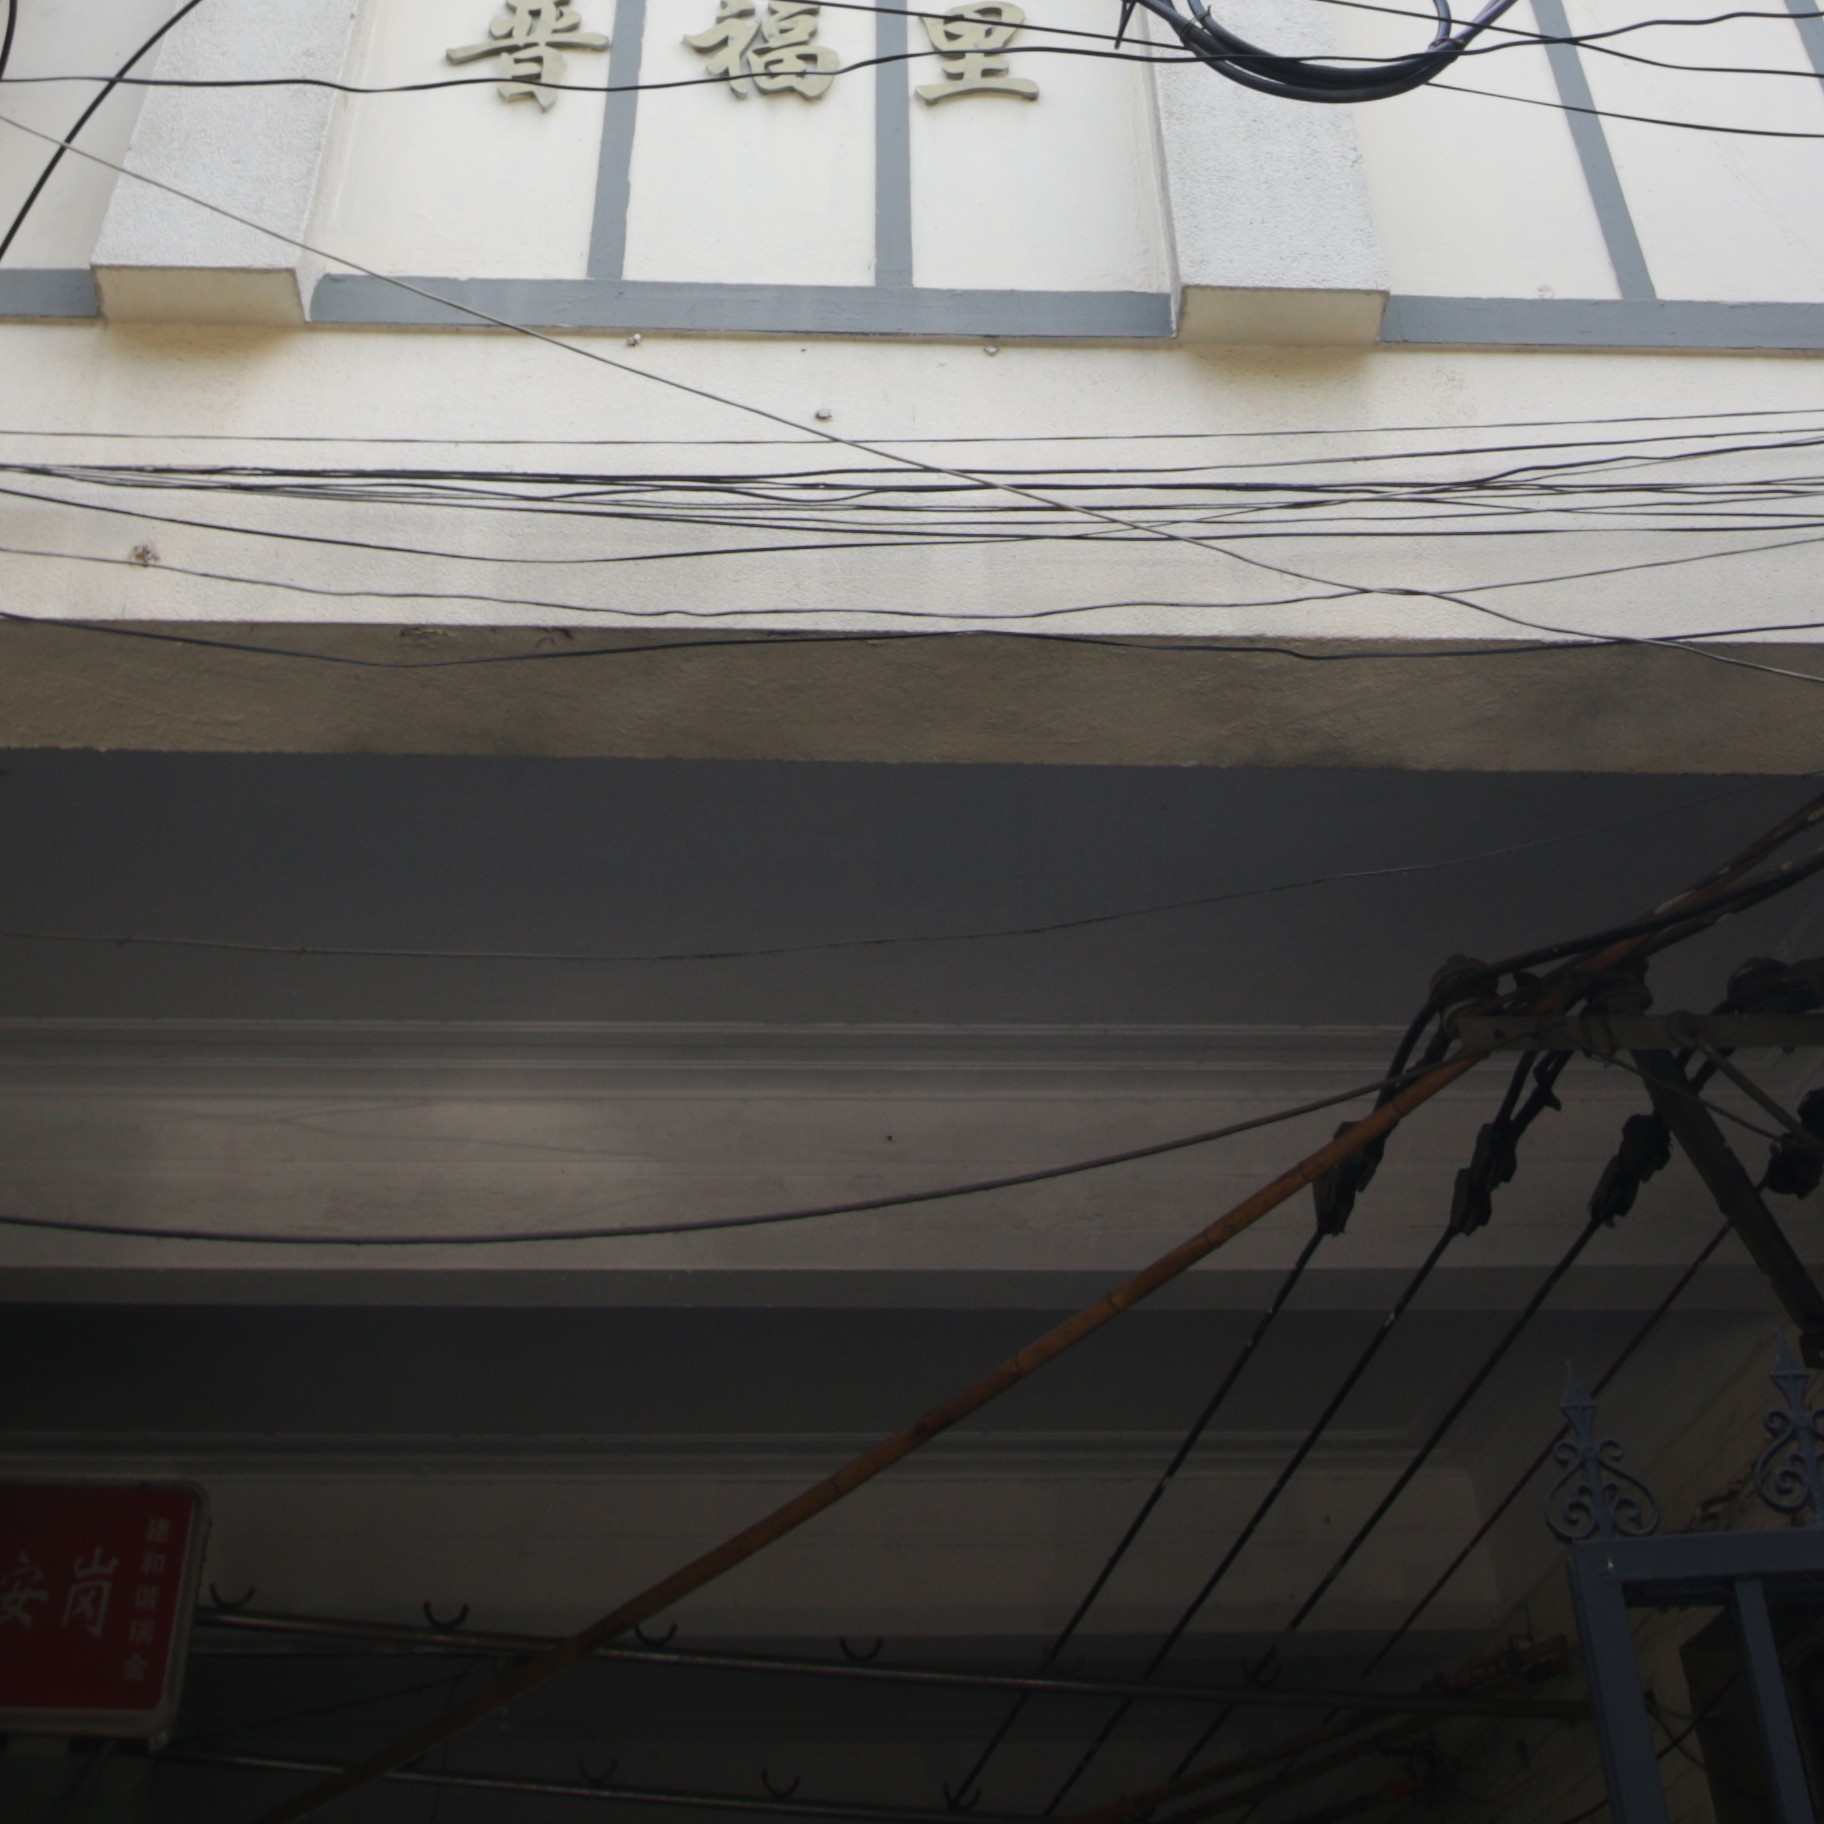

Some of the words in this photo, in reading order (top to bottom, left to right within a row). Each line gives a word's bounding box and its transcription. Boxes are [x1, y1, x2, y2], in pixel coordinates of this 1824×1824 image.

[122, 1517, 171, 1681] 建和谐瑞金
